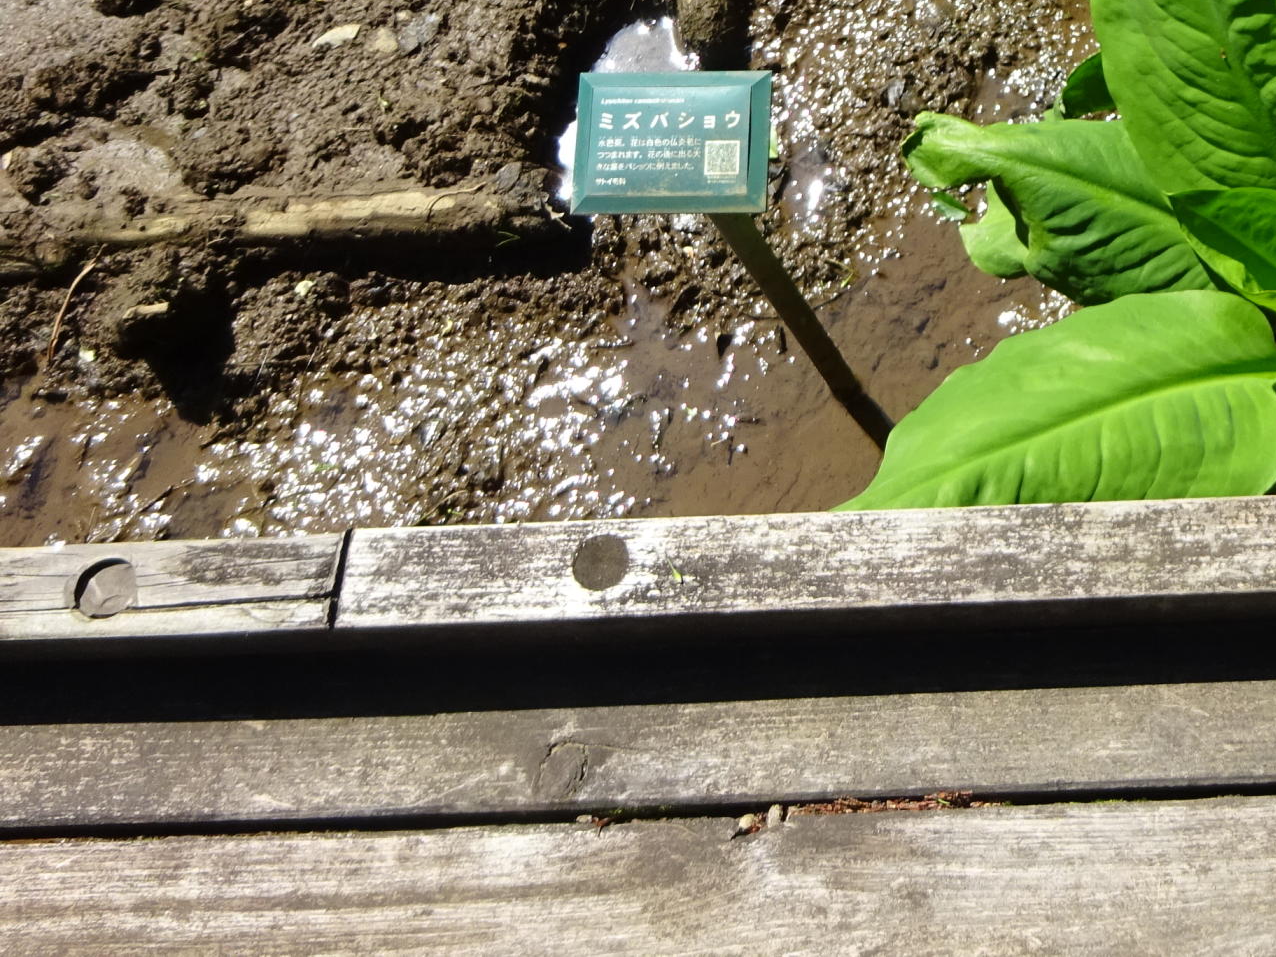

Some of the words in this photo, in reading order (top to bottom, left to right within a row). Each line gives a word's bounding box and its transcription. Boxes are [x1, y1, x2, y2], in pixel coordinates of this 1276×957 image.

[599, 110, 741, 130] ミズバショウ
